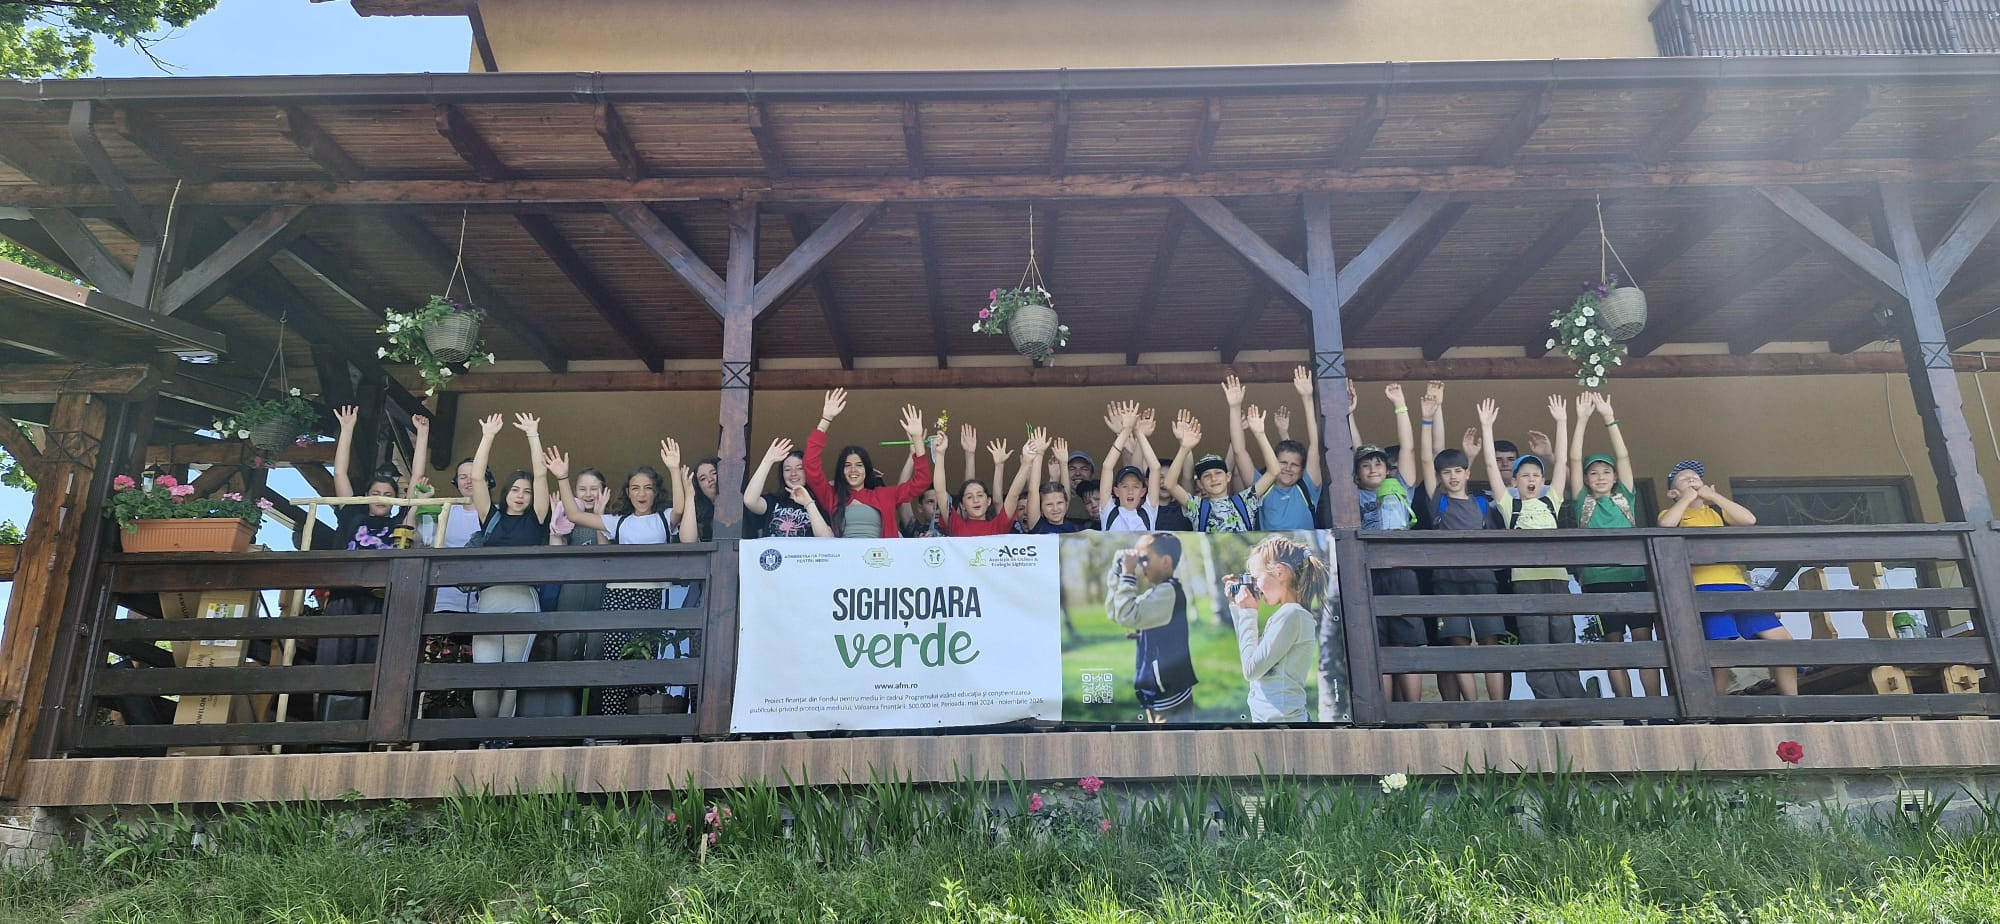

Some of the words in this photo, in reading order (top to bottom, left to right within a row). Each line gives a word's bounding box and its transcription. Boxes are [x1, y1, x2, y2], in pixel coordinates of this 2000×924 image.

[999, 545, 1037, 558] AceS
[832, 586, 982, 629] SIGHIȘOARA
[834, 622, 980, 669] verde
[874, 681, 918, 690] www.afm.ro
[808, 695, 817, 703] din
[840, 695, 859, 704] pentru
[860, 694, 878, 702] mediu
[967, 699, 978, 707] mai
[980, 698, 994, 707] 2024
